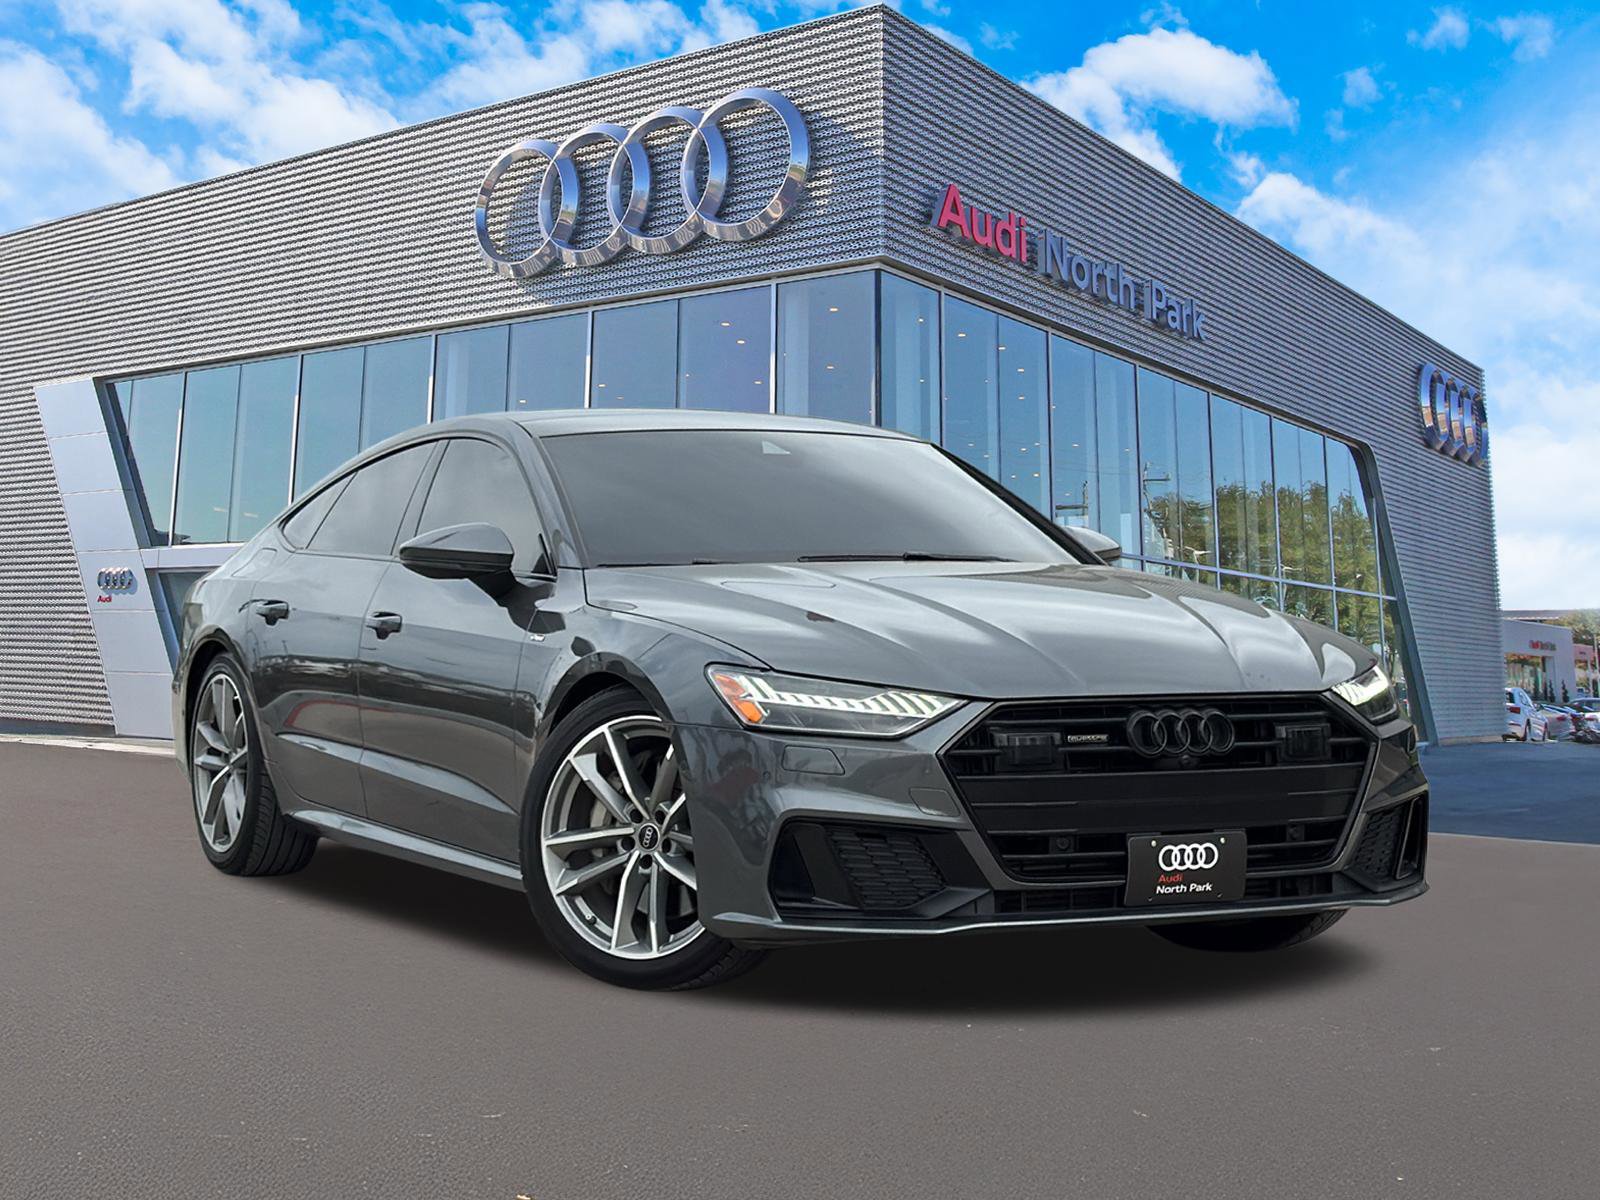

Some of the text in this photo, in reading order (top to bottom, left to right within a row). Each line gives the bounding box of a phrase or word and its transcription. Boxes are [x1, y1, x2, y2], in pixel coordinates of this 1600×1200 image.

[932, 183, 1207, 341] Audi North Park
[1158, 874, 1184, 883] Audi
[1156, 882, 1213, 894] North Park
